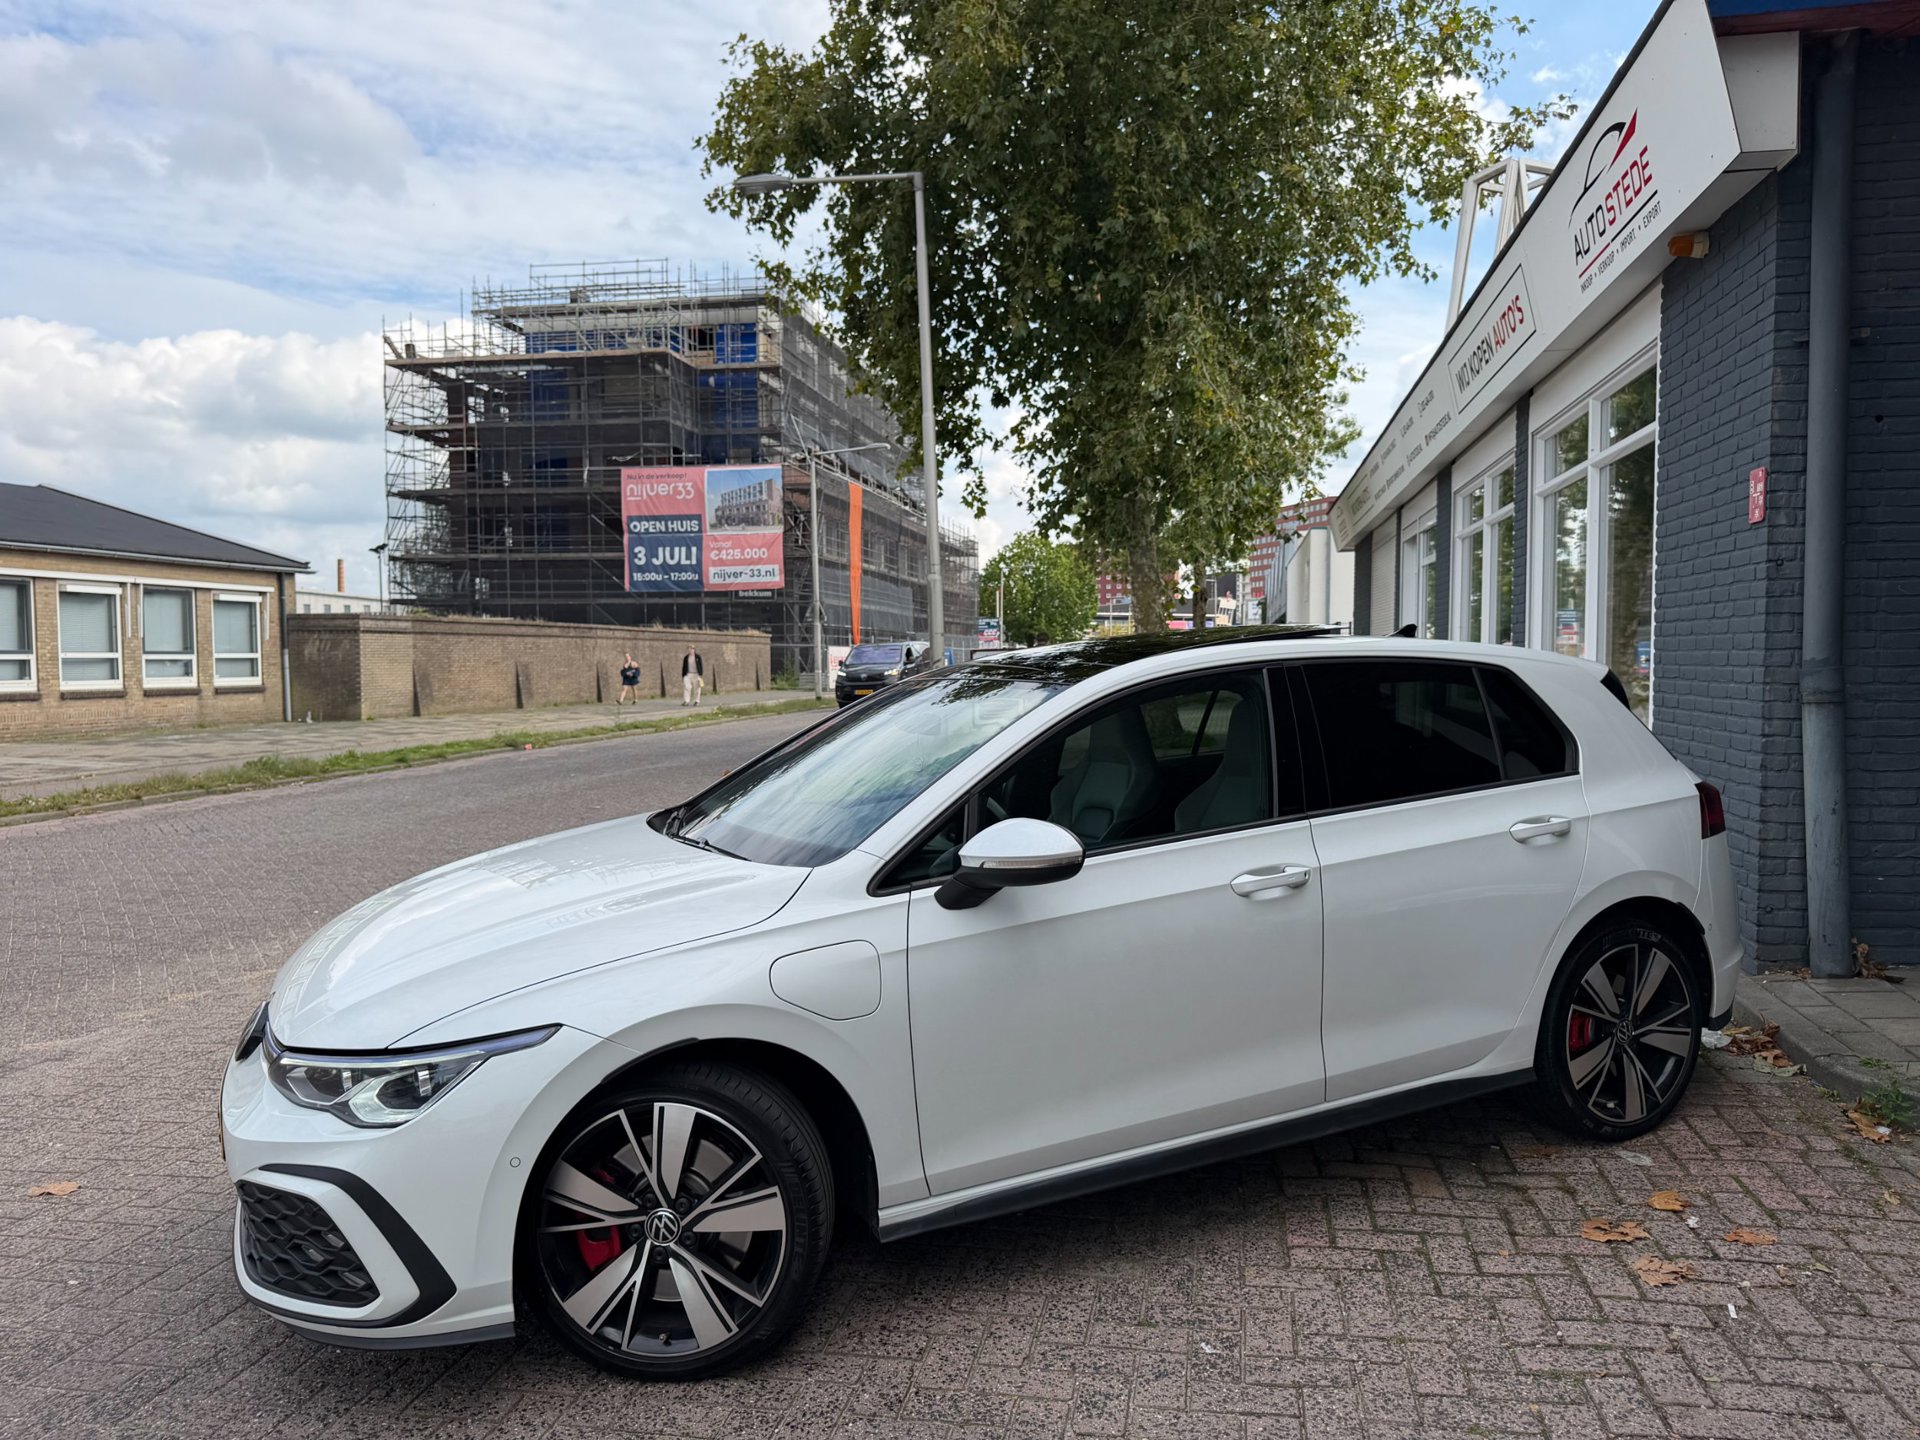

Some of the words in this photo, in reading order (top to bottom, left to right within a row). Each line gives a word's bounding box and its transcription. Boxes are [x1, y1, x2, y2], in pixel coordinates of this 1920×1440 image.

[1597, 251, 1615, 275] VERKOOP
[1619, 228, 1636, 252] IMPORT
[1642, 201, 1661, 228] EXPORT
[1470, 332, 1495, 381] KOPEN
[1492, 295, 1524, 353] AUTO'S
[656, 473, 688, 481] verkoop!
[629, 521, 666, 532] OPEN
[668, 520, 699, 532] HUIS
[633, 545, 647, 566] 3
[651, 546, 697, 566] JULI
[710, 548, 768, 560] €425.000
[633, 572, 663, 581] 15:00u
[670, 571, 699, 580] 17:00u
[713, 568, 775, 581] nijver-33.nl
